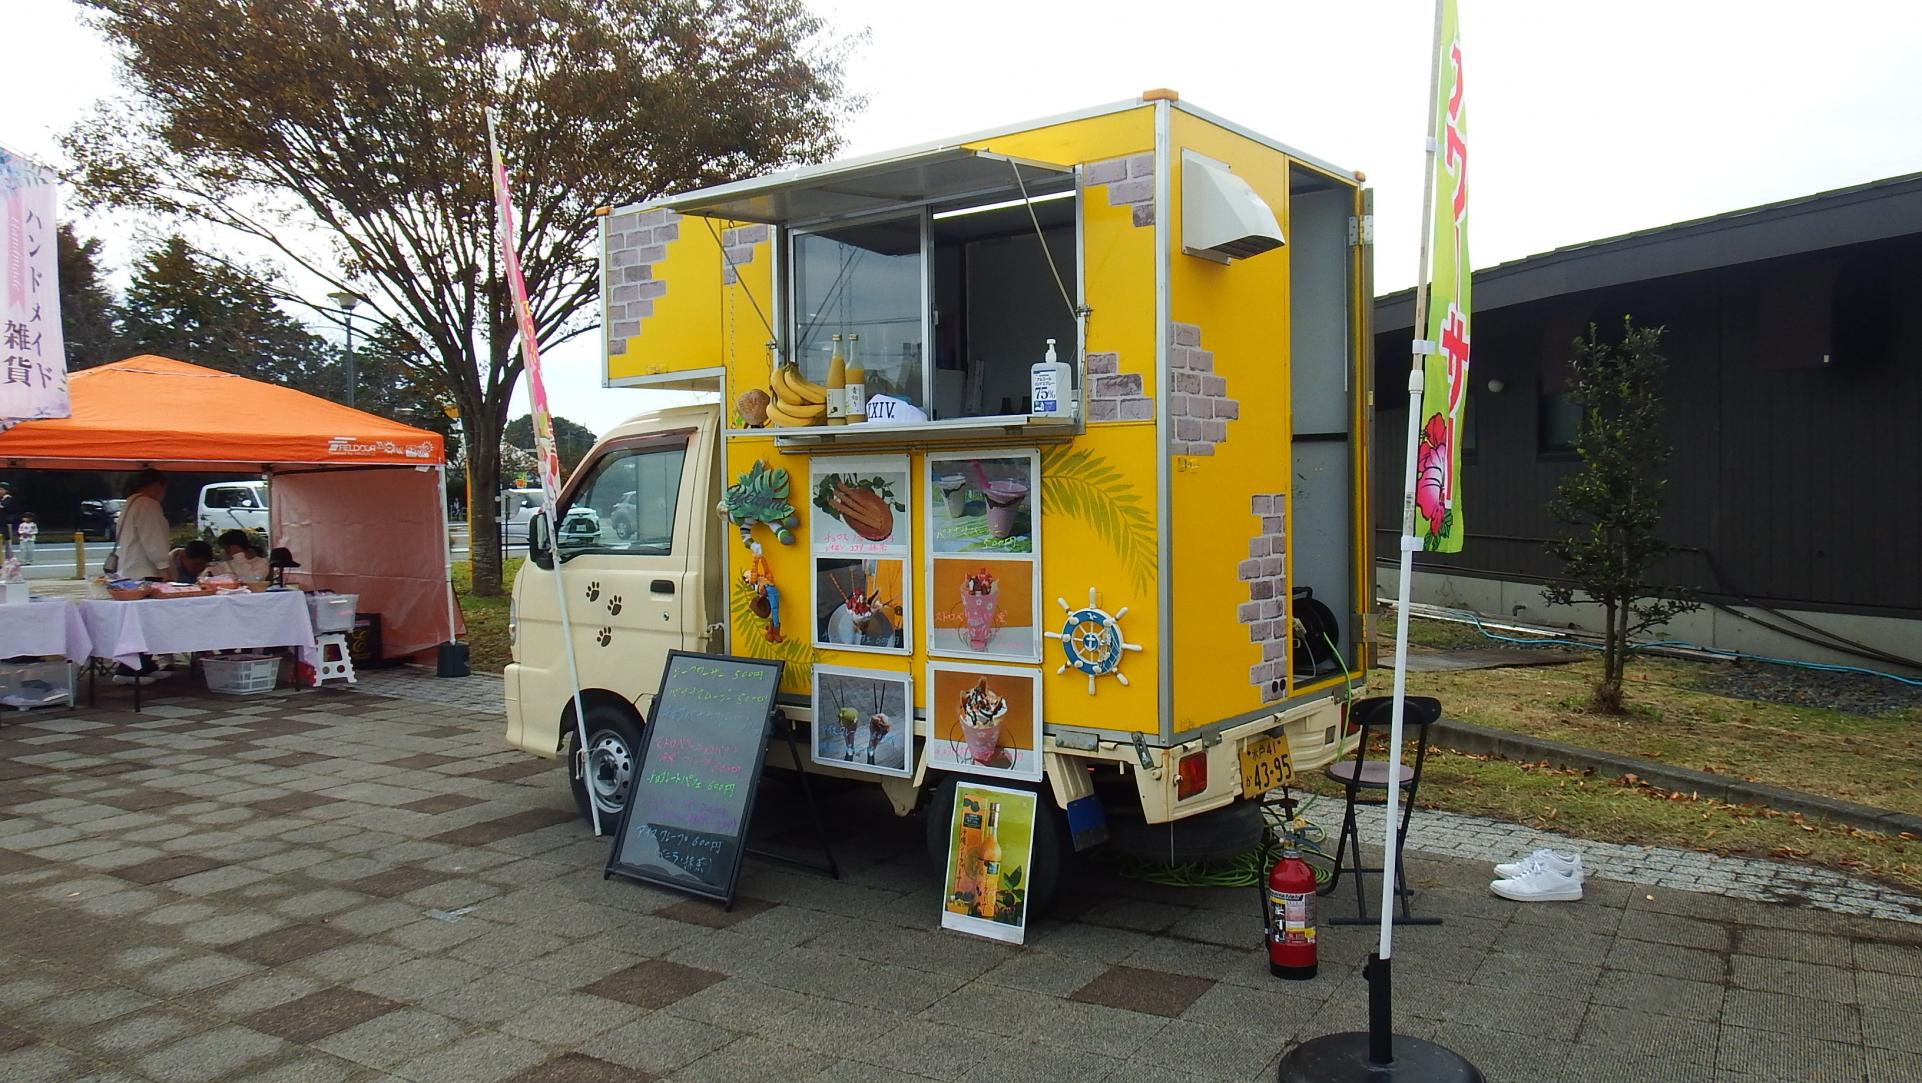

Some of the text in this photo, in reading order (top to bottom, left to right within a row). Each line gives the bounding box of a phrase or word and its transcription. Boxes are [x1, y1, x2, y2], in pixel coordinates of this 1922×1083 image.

[26, 208, 52, 390] ハンドメイド
[3, 319, 33, 387] 雑貨
[1035, 387, 1056, 400] 75%
